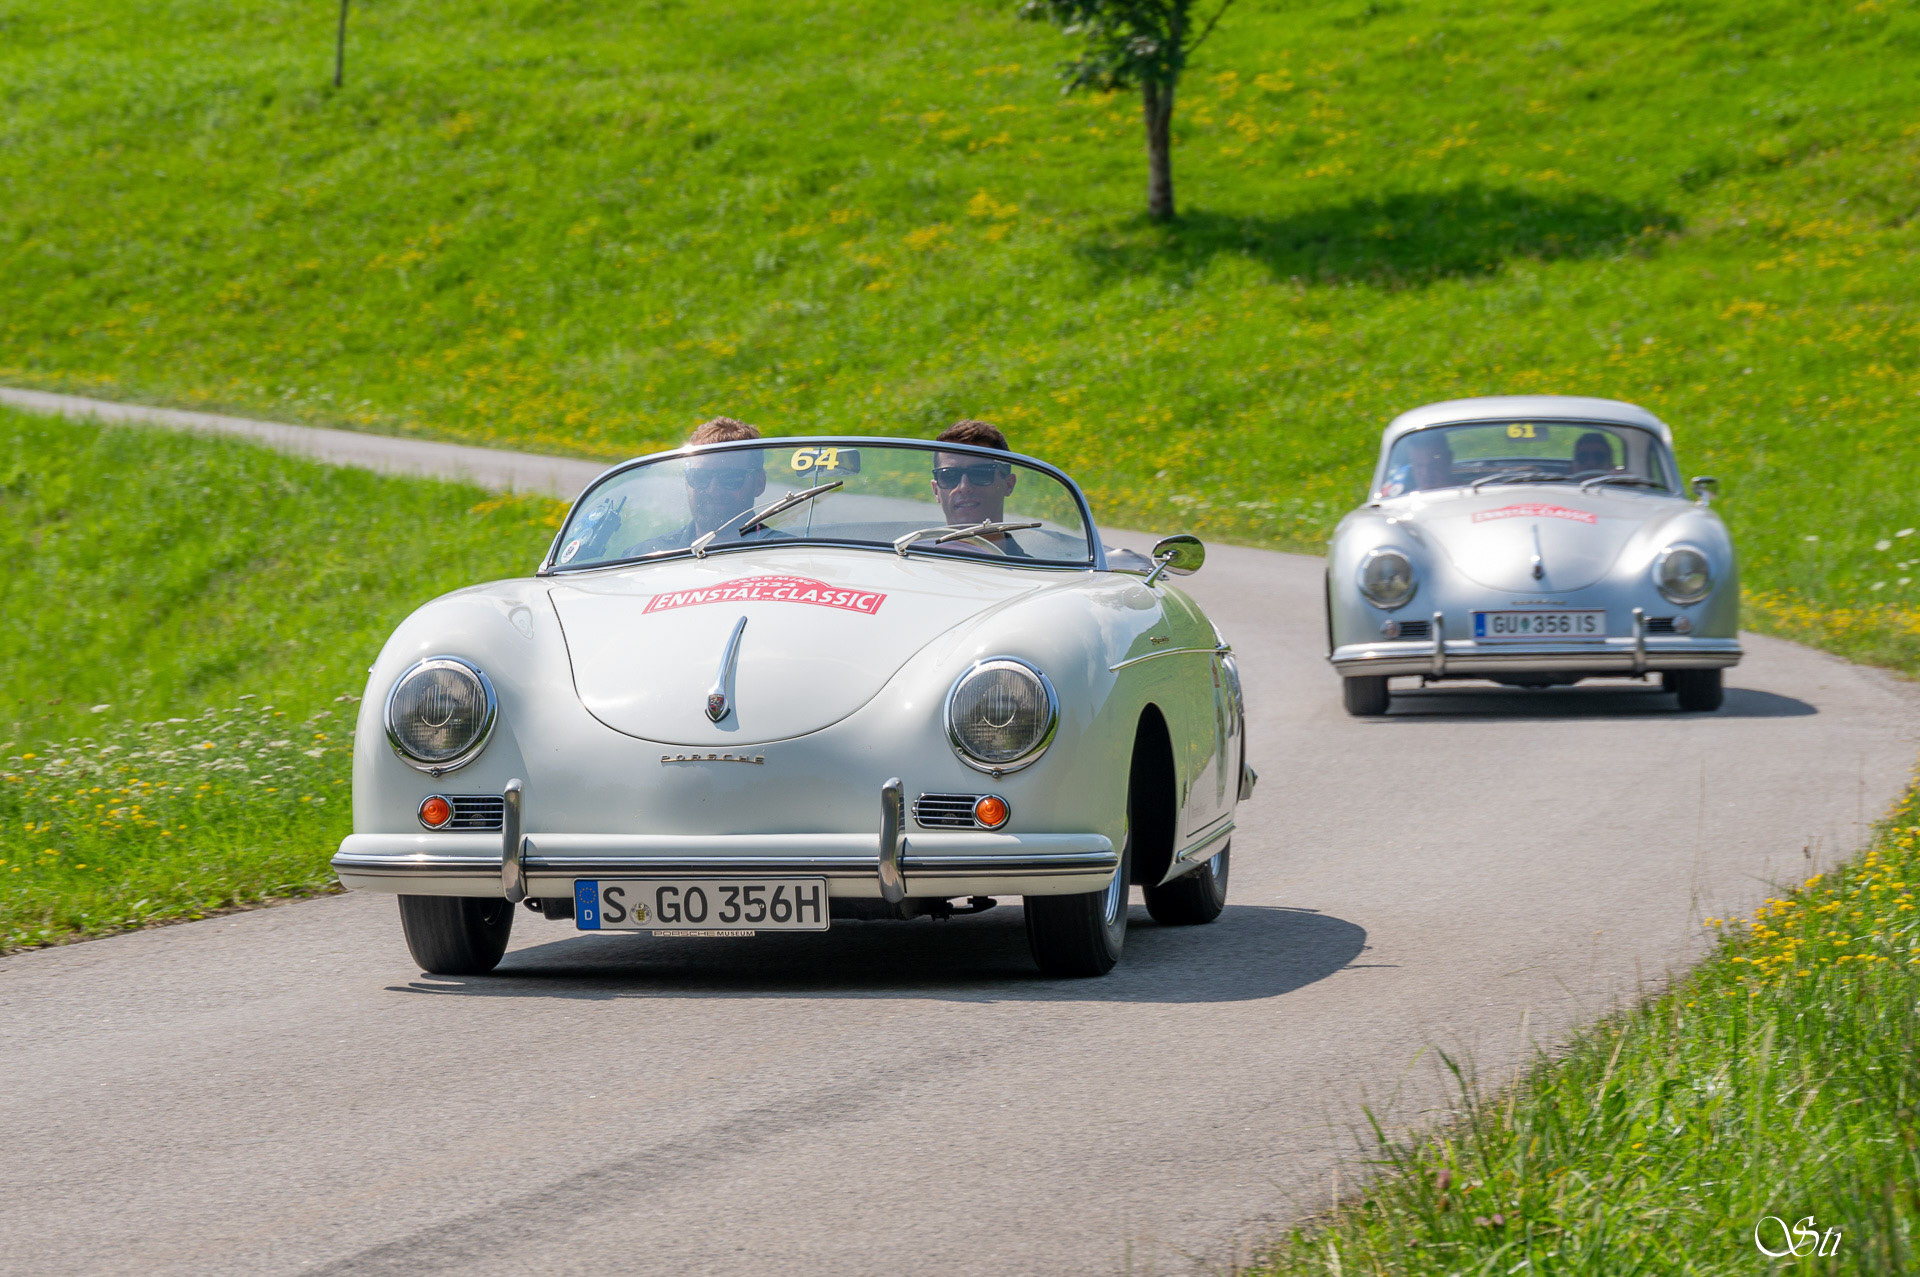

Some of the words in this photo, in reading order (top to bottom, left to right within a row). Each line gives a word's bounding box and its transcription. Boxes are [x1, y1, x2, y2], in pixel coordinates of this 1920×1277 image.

[1506, 423, 1537, 438] 61
[790, 447, 839, 471] 64
[655, 586, 872, 610] ENNSTAL-CLASSIC
[1493, 615, 1518, 634] GU
[1533, 615, 1570, 633] 356
[1575, 615, 1596, 633] IS
[661, 754, 765, 764] PORSCHE
[602, 886, 627, 923] S
[655, 886, 708, 923] GO
[718, 885, 821, 923] 356H
[584, 909, 593, 921] D
